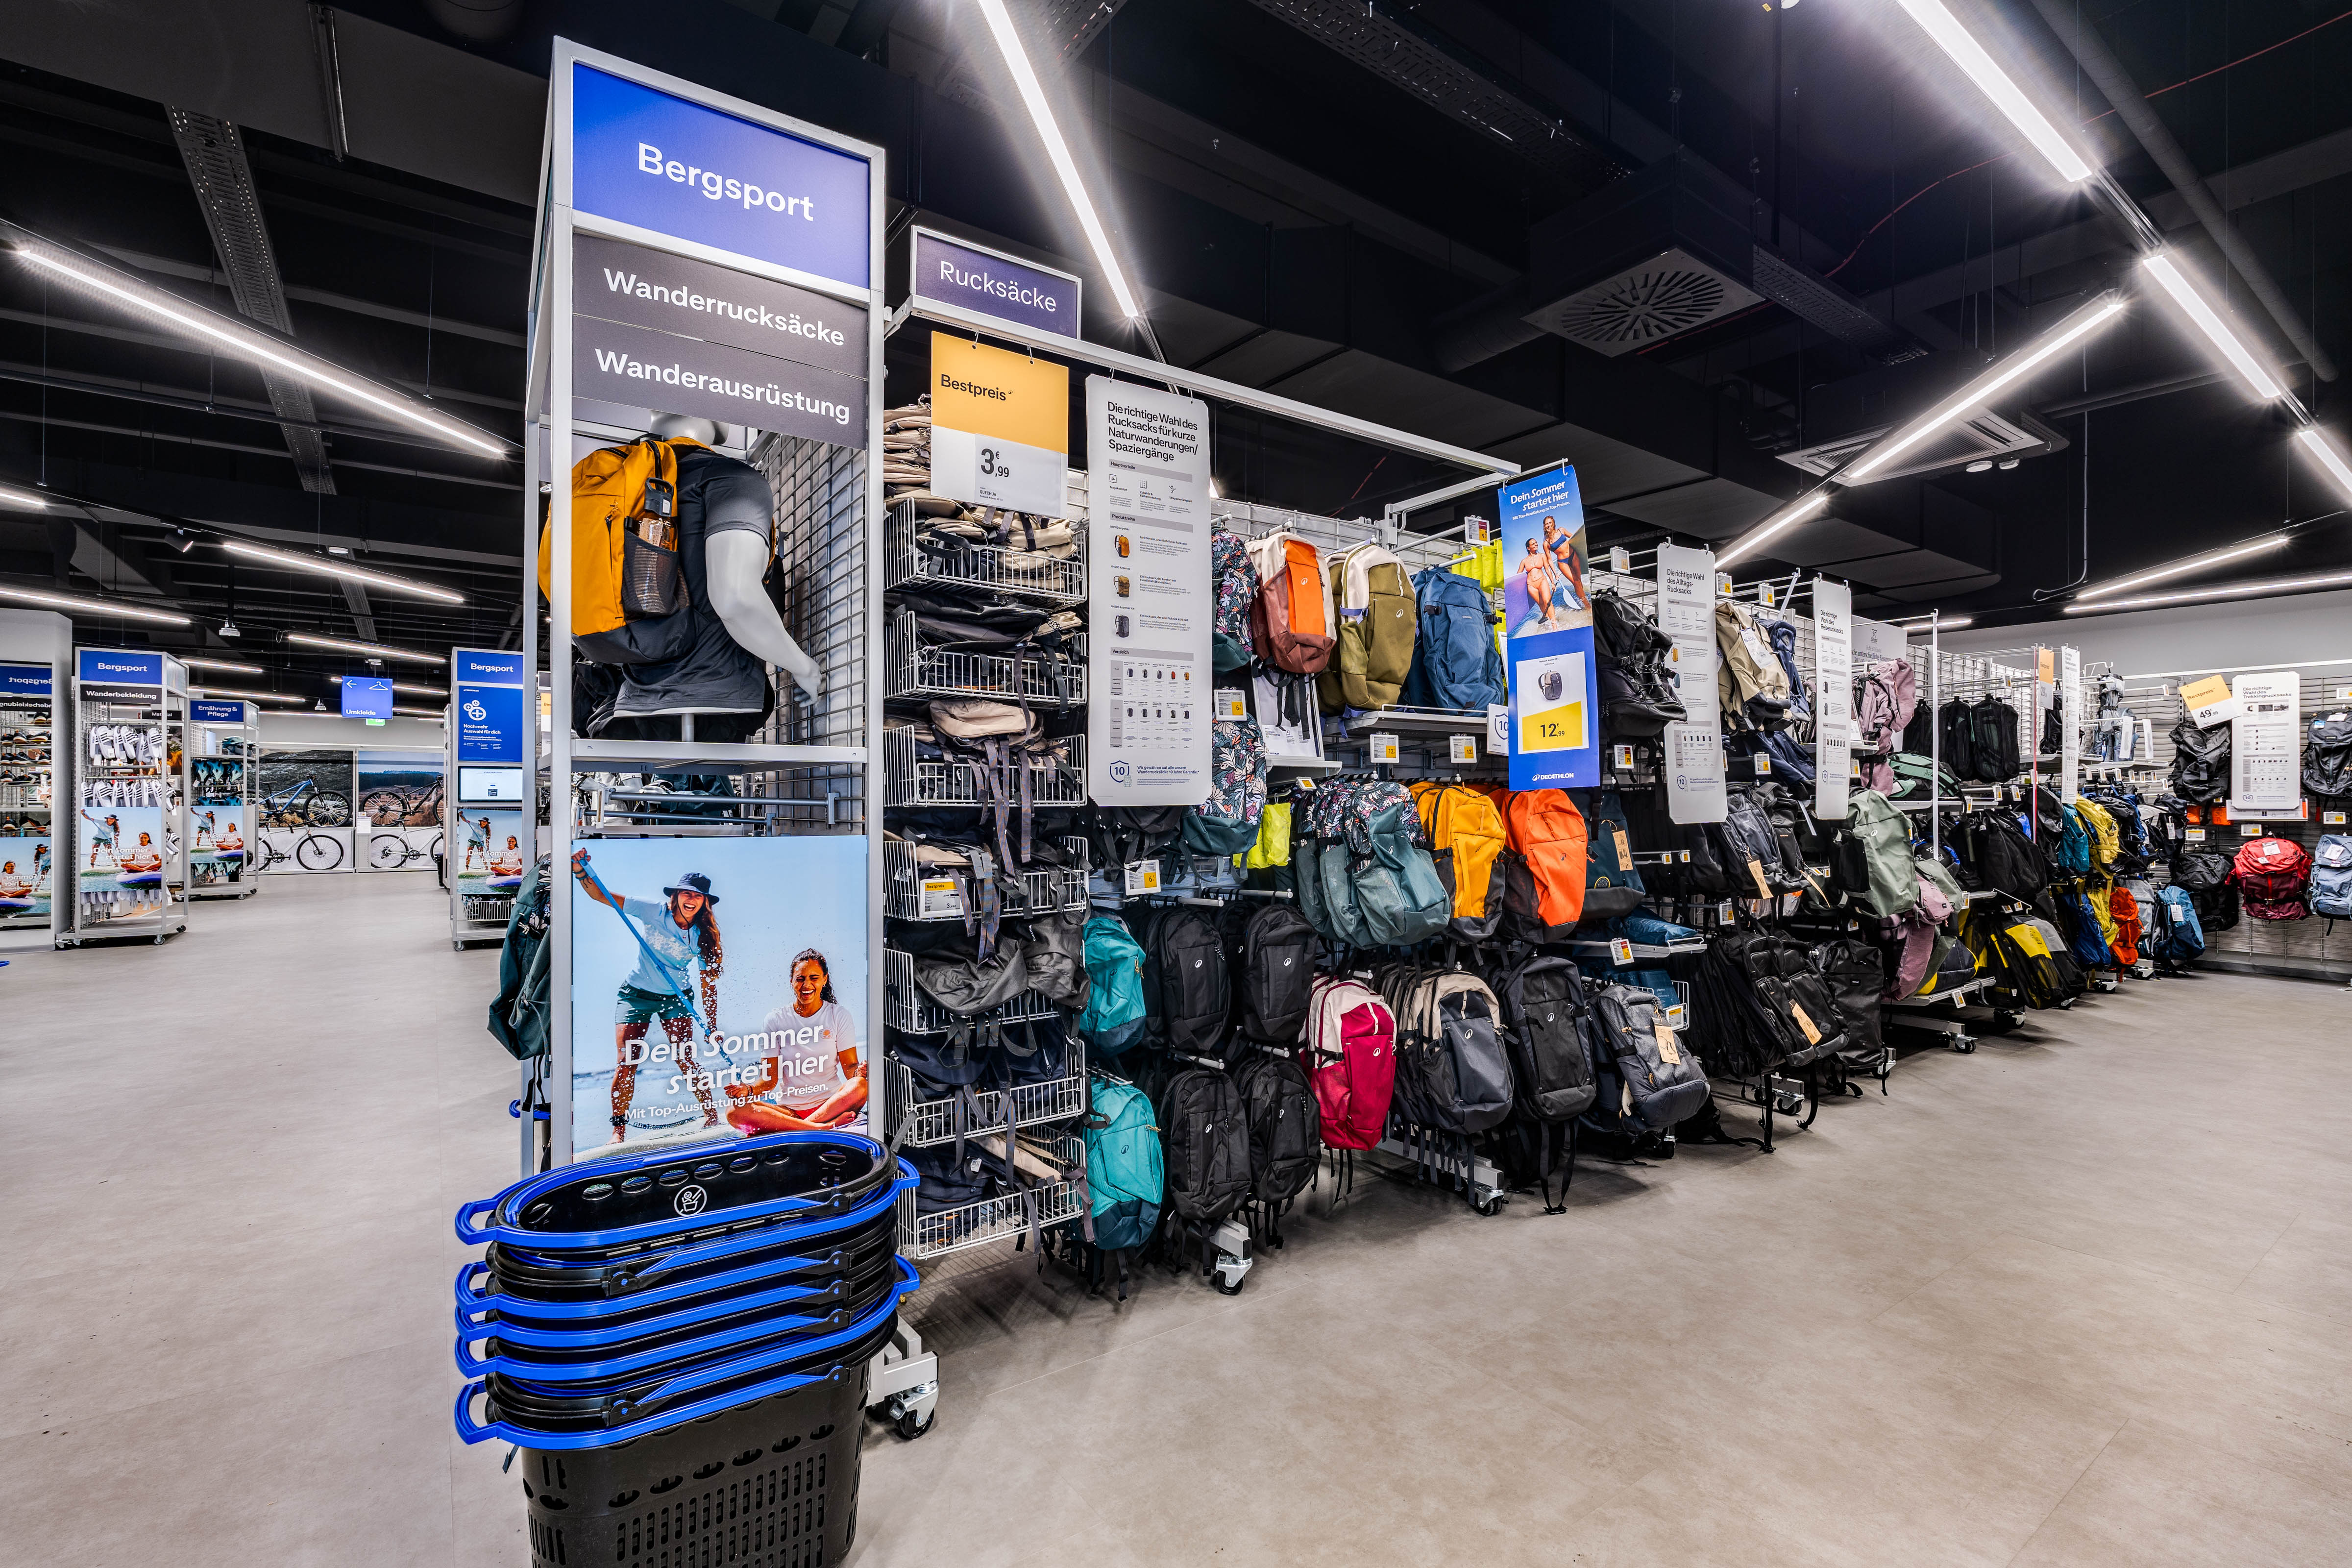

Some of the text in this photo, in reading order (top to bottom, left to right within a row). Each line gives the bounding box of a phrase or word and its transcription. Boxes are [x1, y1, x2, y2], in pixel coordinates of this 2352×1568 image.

[637, 142, 814, 221] Bergsport
[940, 260, 1057, 313] Rucksäcke
[603, 267, 845, 346] Wanderrucksäcke
[594, 348, 850, 425] Wanderausrüstung
[941, 373, 1006, 401] Bestpreis
[1107, 401, 1198, 430] Die richtige Wahl des
[1108, 414, 1196, 441] Rucksacks für kurze
[1108, 426, 1198, 455] Naturwanderungen/
[1109, 439, 1174, 462] Spaziergänge
[1511, 481, 1566, 504] Dein Sommer
[1522, 491, 1568, 511] startet hier
[1519, 509, 1545, 518] Top-Ausrüstung
[1675, 570, 1692, 580] richtige
[1676, 579, 1693, 588] Alltags-
[1667, 586, 1691, 594] Rucksacks
[1826, 612, 1837, 620] richtige
[98, 662, 147, 672] Bergsport
[471, 663, 514, 672] Bergsport
[86, 690, 157, 700] Wanderbekleidung
[2187, 689, 2214, 701] Bestpreis
[1499, 721, 1508, 731] 10
[1114, 767, 1125, 775] 10
[625, 1025, 824, 1066] Dein Sommer
[667, 1053, 829, 1095] startet hier
[625, 1083, 829, 1121] Mit Top-Ausrüstung zu Top-Preisen.
